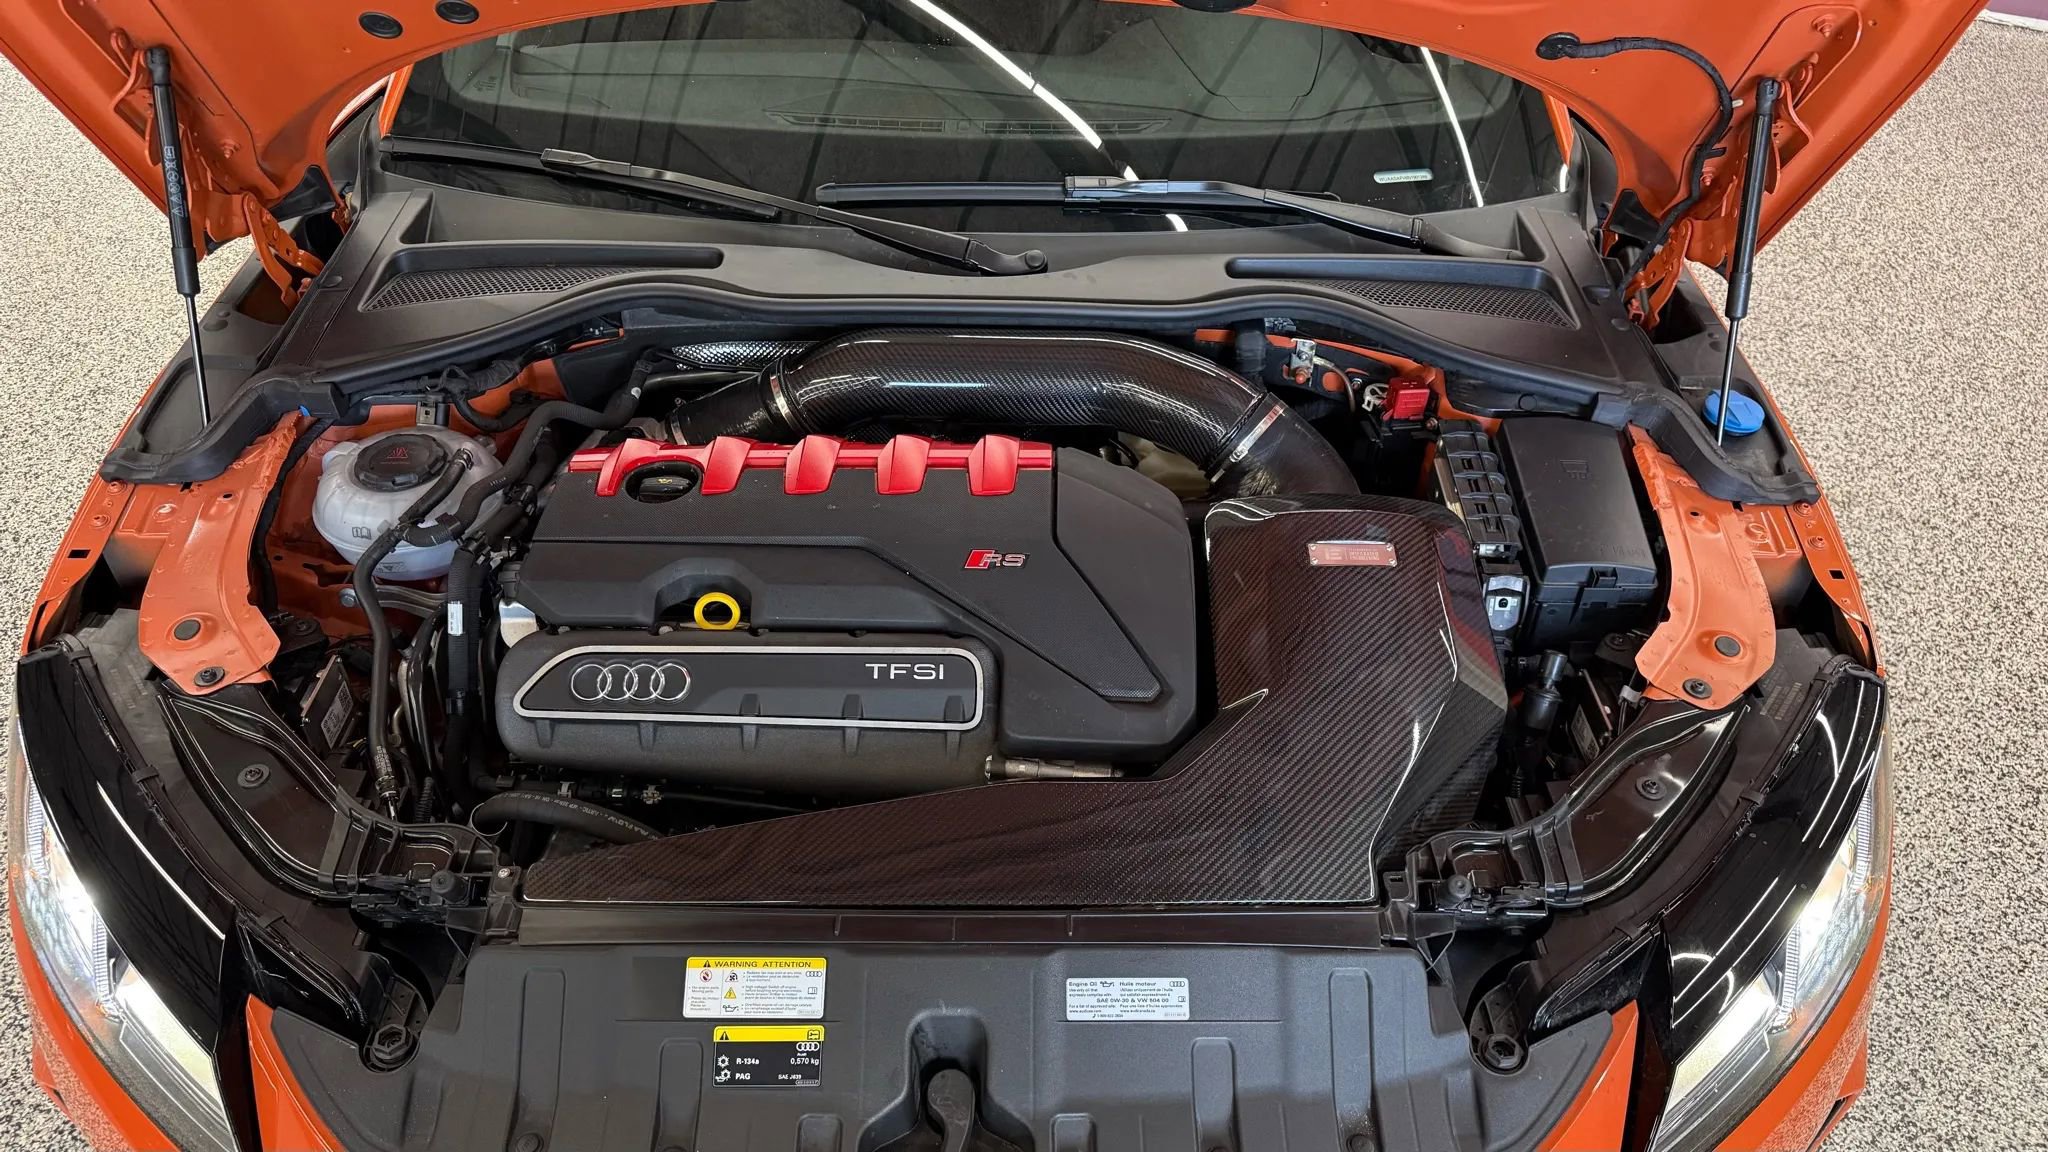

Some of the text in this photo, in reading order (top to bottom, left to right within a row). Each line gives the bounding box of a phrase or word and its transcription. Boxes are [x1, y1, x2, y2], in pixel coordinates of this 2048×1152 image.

[977, 552, 1027, 568] RS
[866, 664, 944, 680] TFSI
[790, 1057, 820, 1066] 0,570 kg
